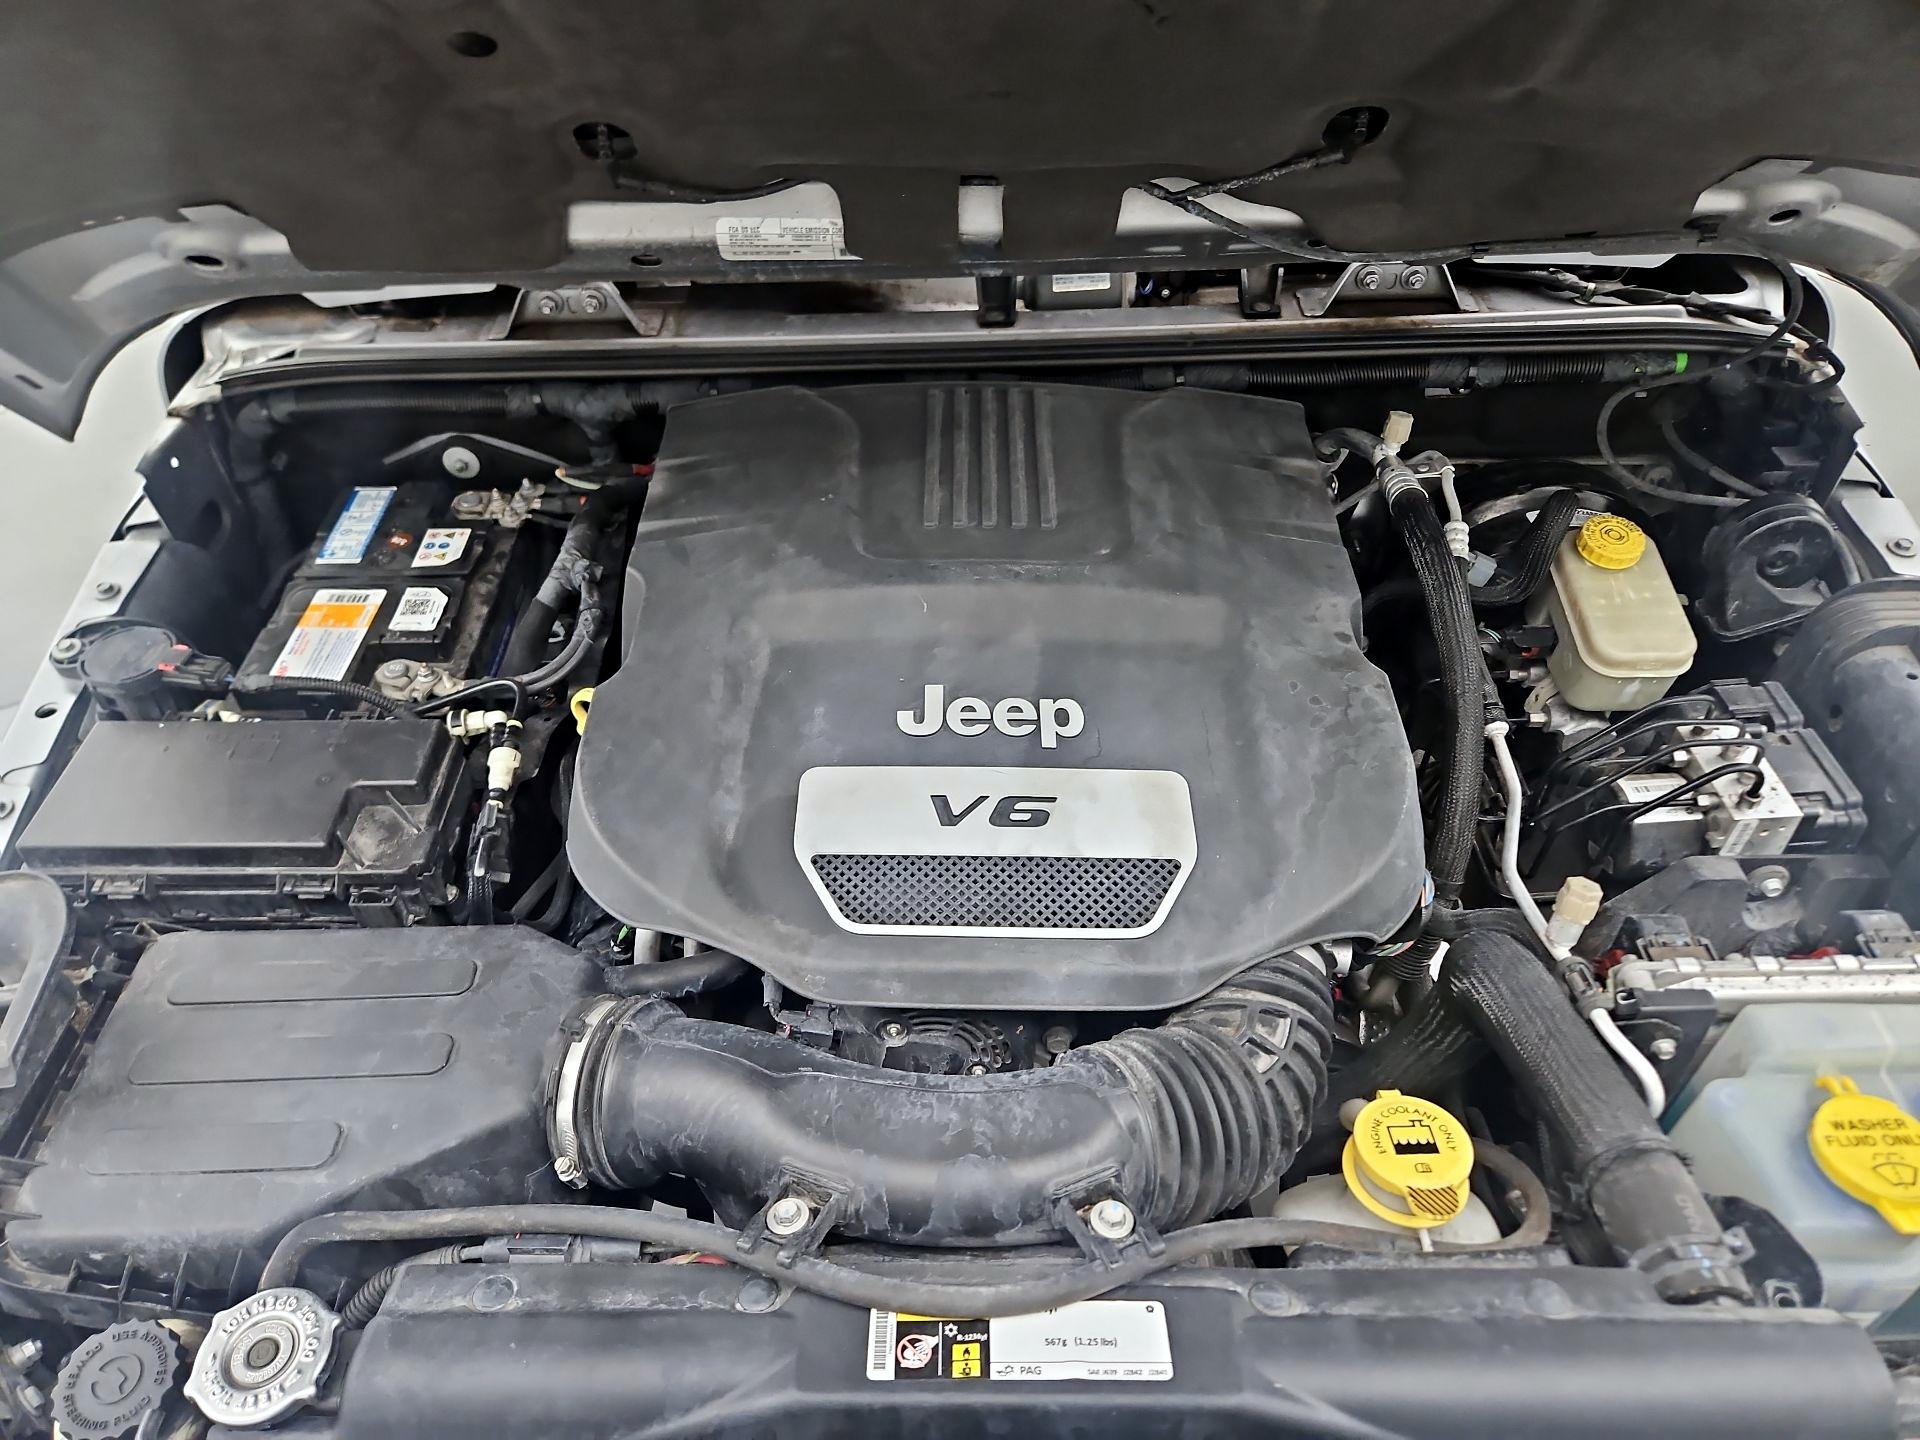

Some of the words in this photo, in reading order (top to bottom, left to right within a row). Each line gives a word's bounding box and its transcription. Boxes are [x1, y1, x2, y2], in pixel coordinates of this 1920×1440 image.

[782, 226, 804, 234] VEHICLE
[896, 684, 1086, 749] Jeep
[929, 794, 1059, 828] V6
[1370, 1117, 1387, 1155] ENGINE
[1380, 1105, 1438, 1122] COOLANT
[1438, 1124, 1457, 1152] ONLY
[1830, 1118, 1908, 1131] WASHER
[1824, 1134, 1877, 1147] FLUID
[1044, 1337, 1068, 1348] 567g
[1074, 1336, 1099, 1347] (1.25
[1100, 1336, 1118, 1347] lbs)
[112, 1329, 139, 1341] USE
[140, 1330, 168, 1385] APPROVED
[1020, 1365, 1042, 1376] PAG
[62, 1392, 109, 1430] STEERING
